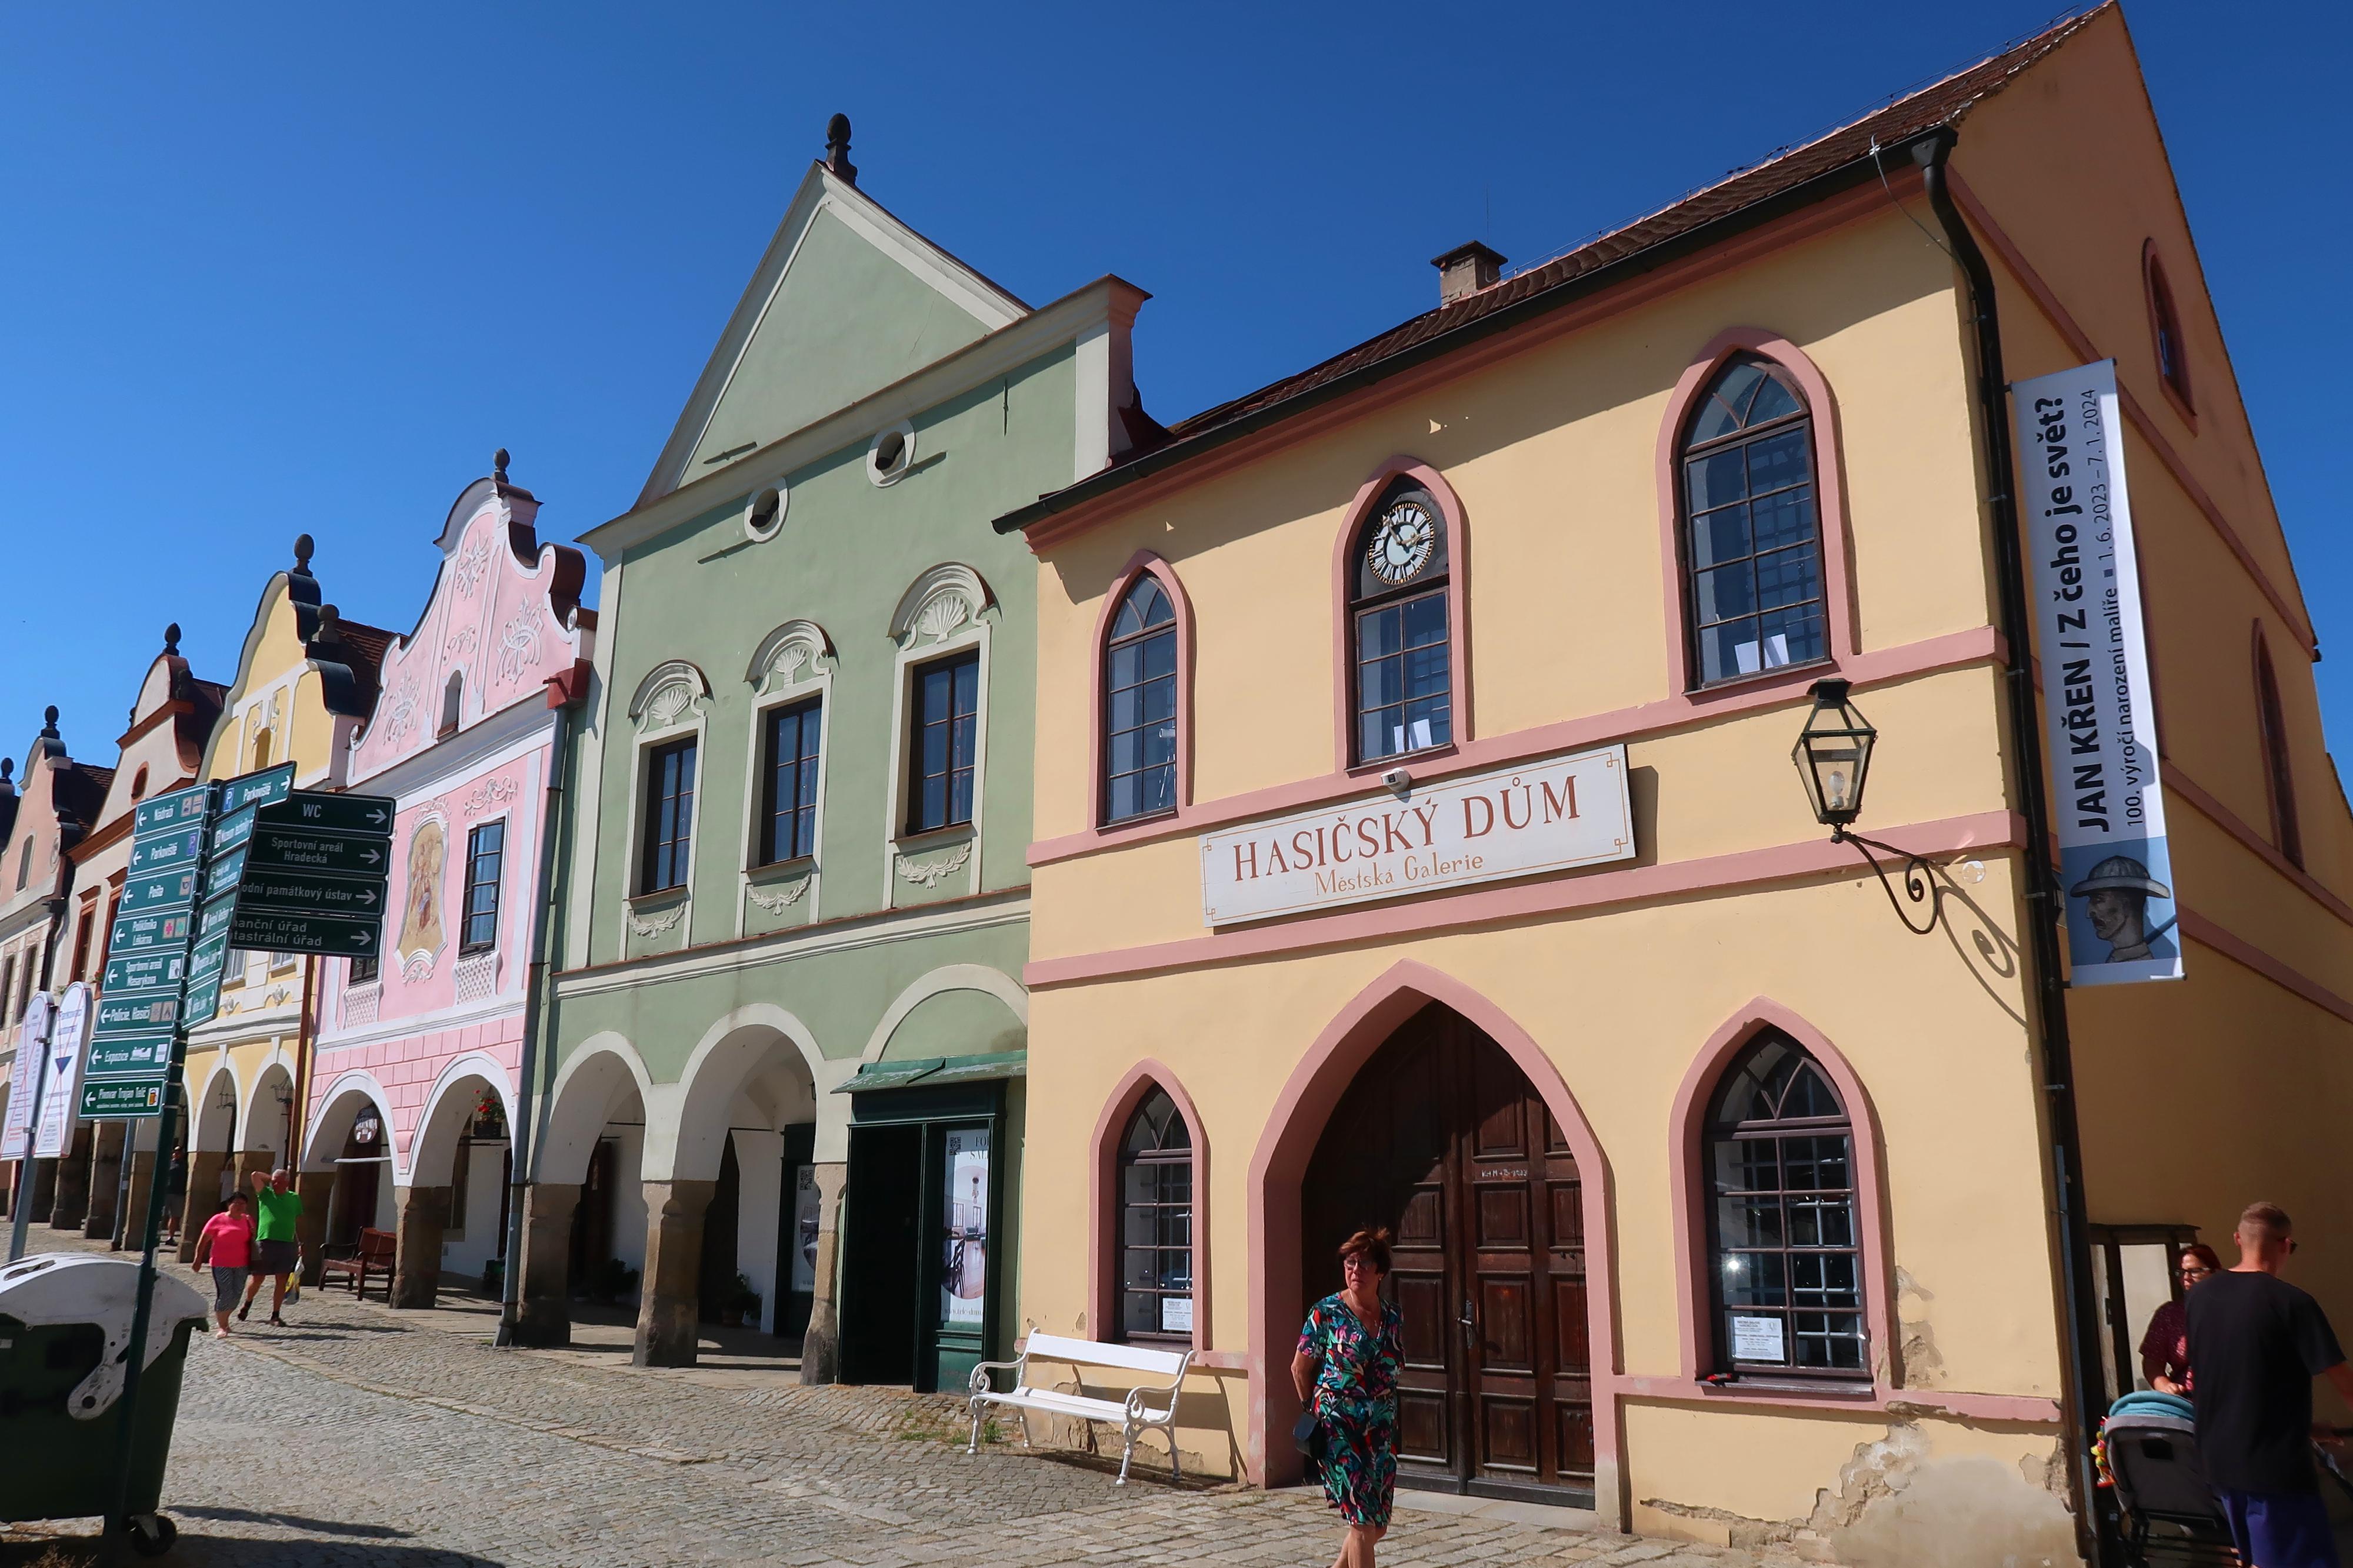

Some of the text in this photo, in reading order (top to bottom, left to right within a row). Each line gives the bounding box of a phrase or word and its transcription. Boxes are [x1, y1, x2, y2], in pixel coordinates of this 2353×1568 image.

[2034, 398, 2071, 479] svět?
[2045, 486, 2084, 518] je
[2050, 524, 2084, 602] čeho
[2057, 609, 2087, 634] Z
[2102, 588, 2123, 643] malíře
[2108, 648, 2132, 725] narození
[2061, 658, 2100, 755] KŘEN
[2117, 730, 2143, 786] výročí
[303, 803, 322, 818] WC
[2073, 763, 2110, 833] JAN
[2125, 790, 2144, 827] 100.
[271, 836, 344, 853] Sportovní areál
[1233, 775, 1582, 882] HASIČSKÝ DŮM
[284, 850, 329, 864] Hradecká
[242, 882, 353, 901] odní památkový ústav
[1314, 853, 1484, 896] Městská Galerie
[233, 930, 322, 946] tastrální úřad
[278, 920, 307, 932] úřad
[969, 1149, 989, 1160] SAL
[975, 1136, 988, 1147] FO
